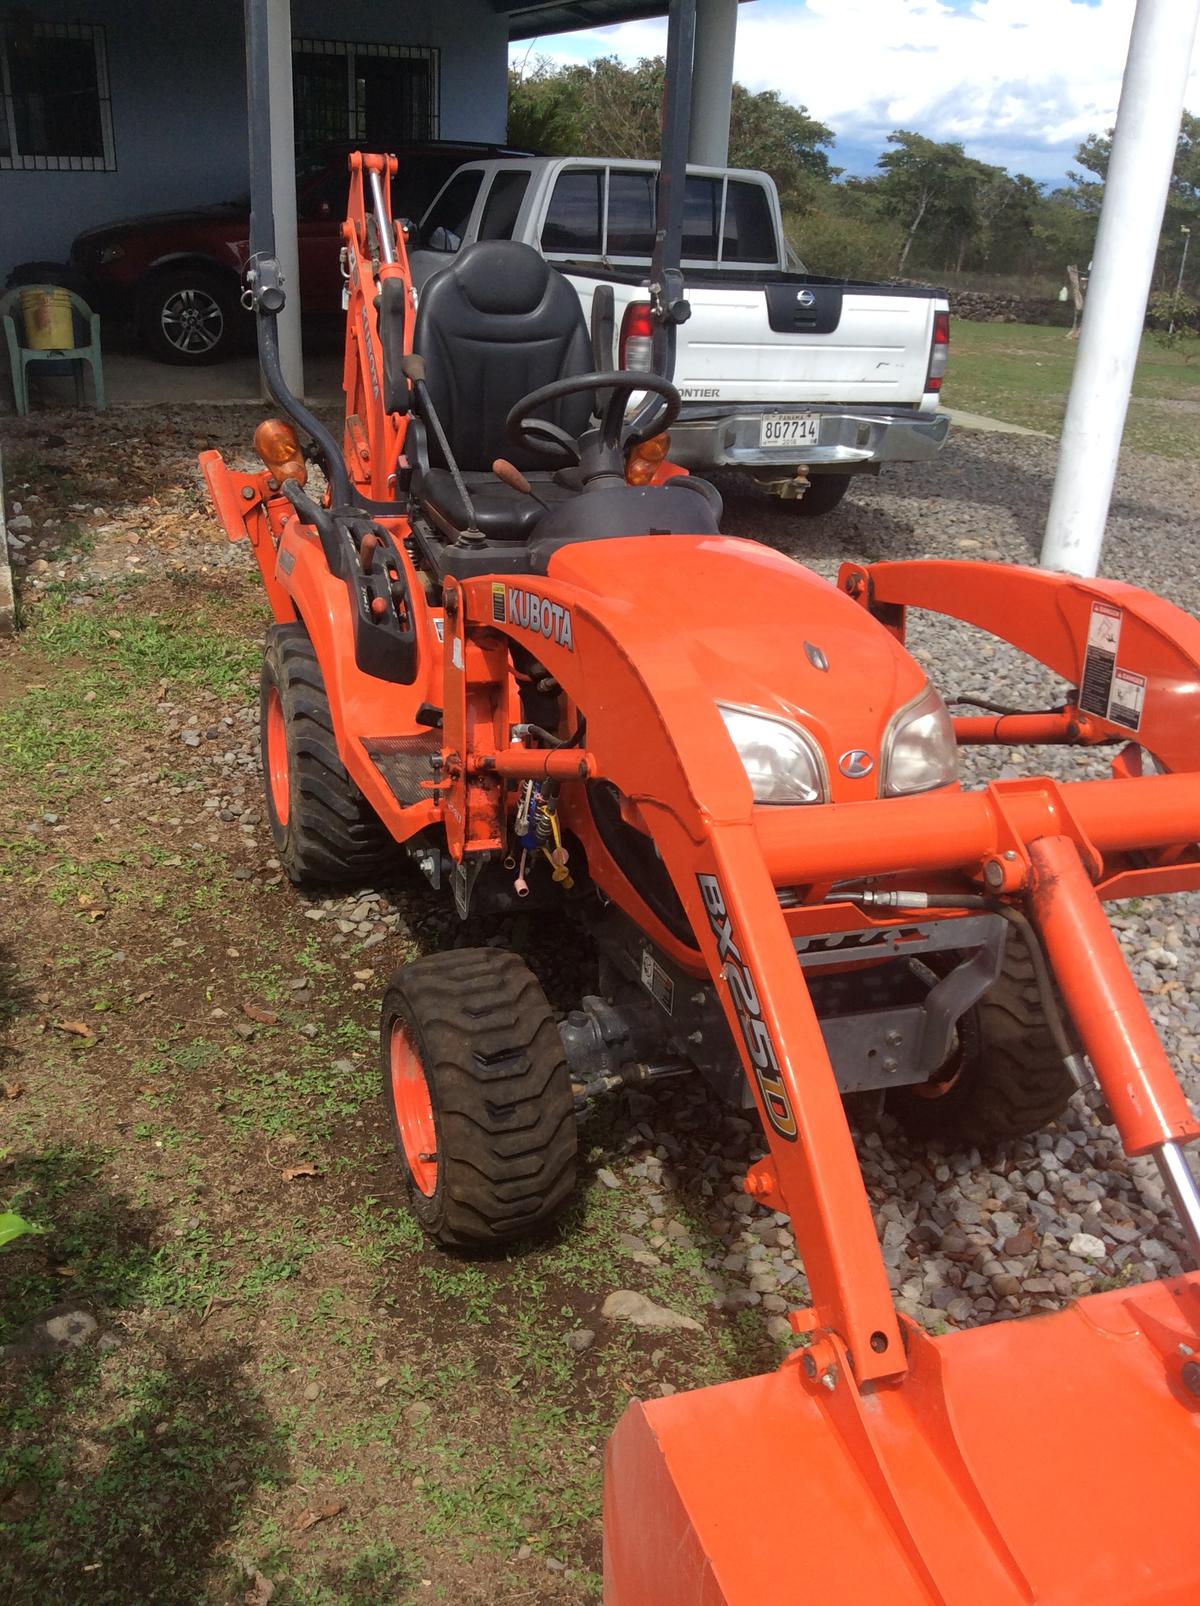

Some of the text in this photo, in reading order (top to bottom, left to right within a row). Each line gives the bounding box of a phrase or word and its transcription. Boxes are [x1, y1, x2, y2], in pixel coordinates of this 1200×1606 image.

[678, 388, 720, 398] ONTIER
[765, 421, 815, 439] 807714
[508, 587, 574, 652] KUBOTA
[695, 873, 798, 1143] BX25D
